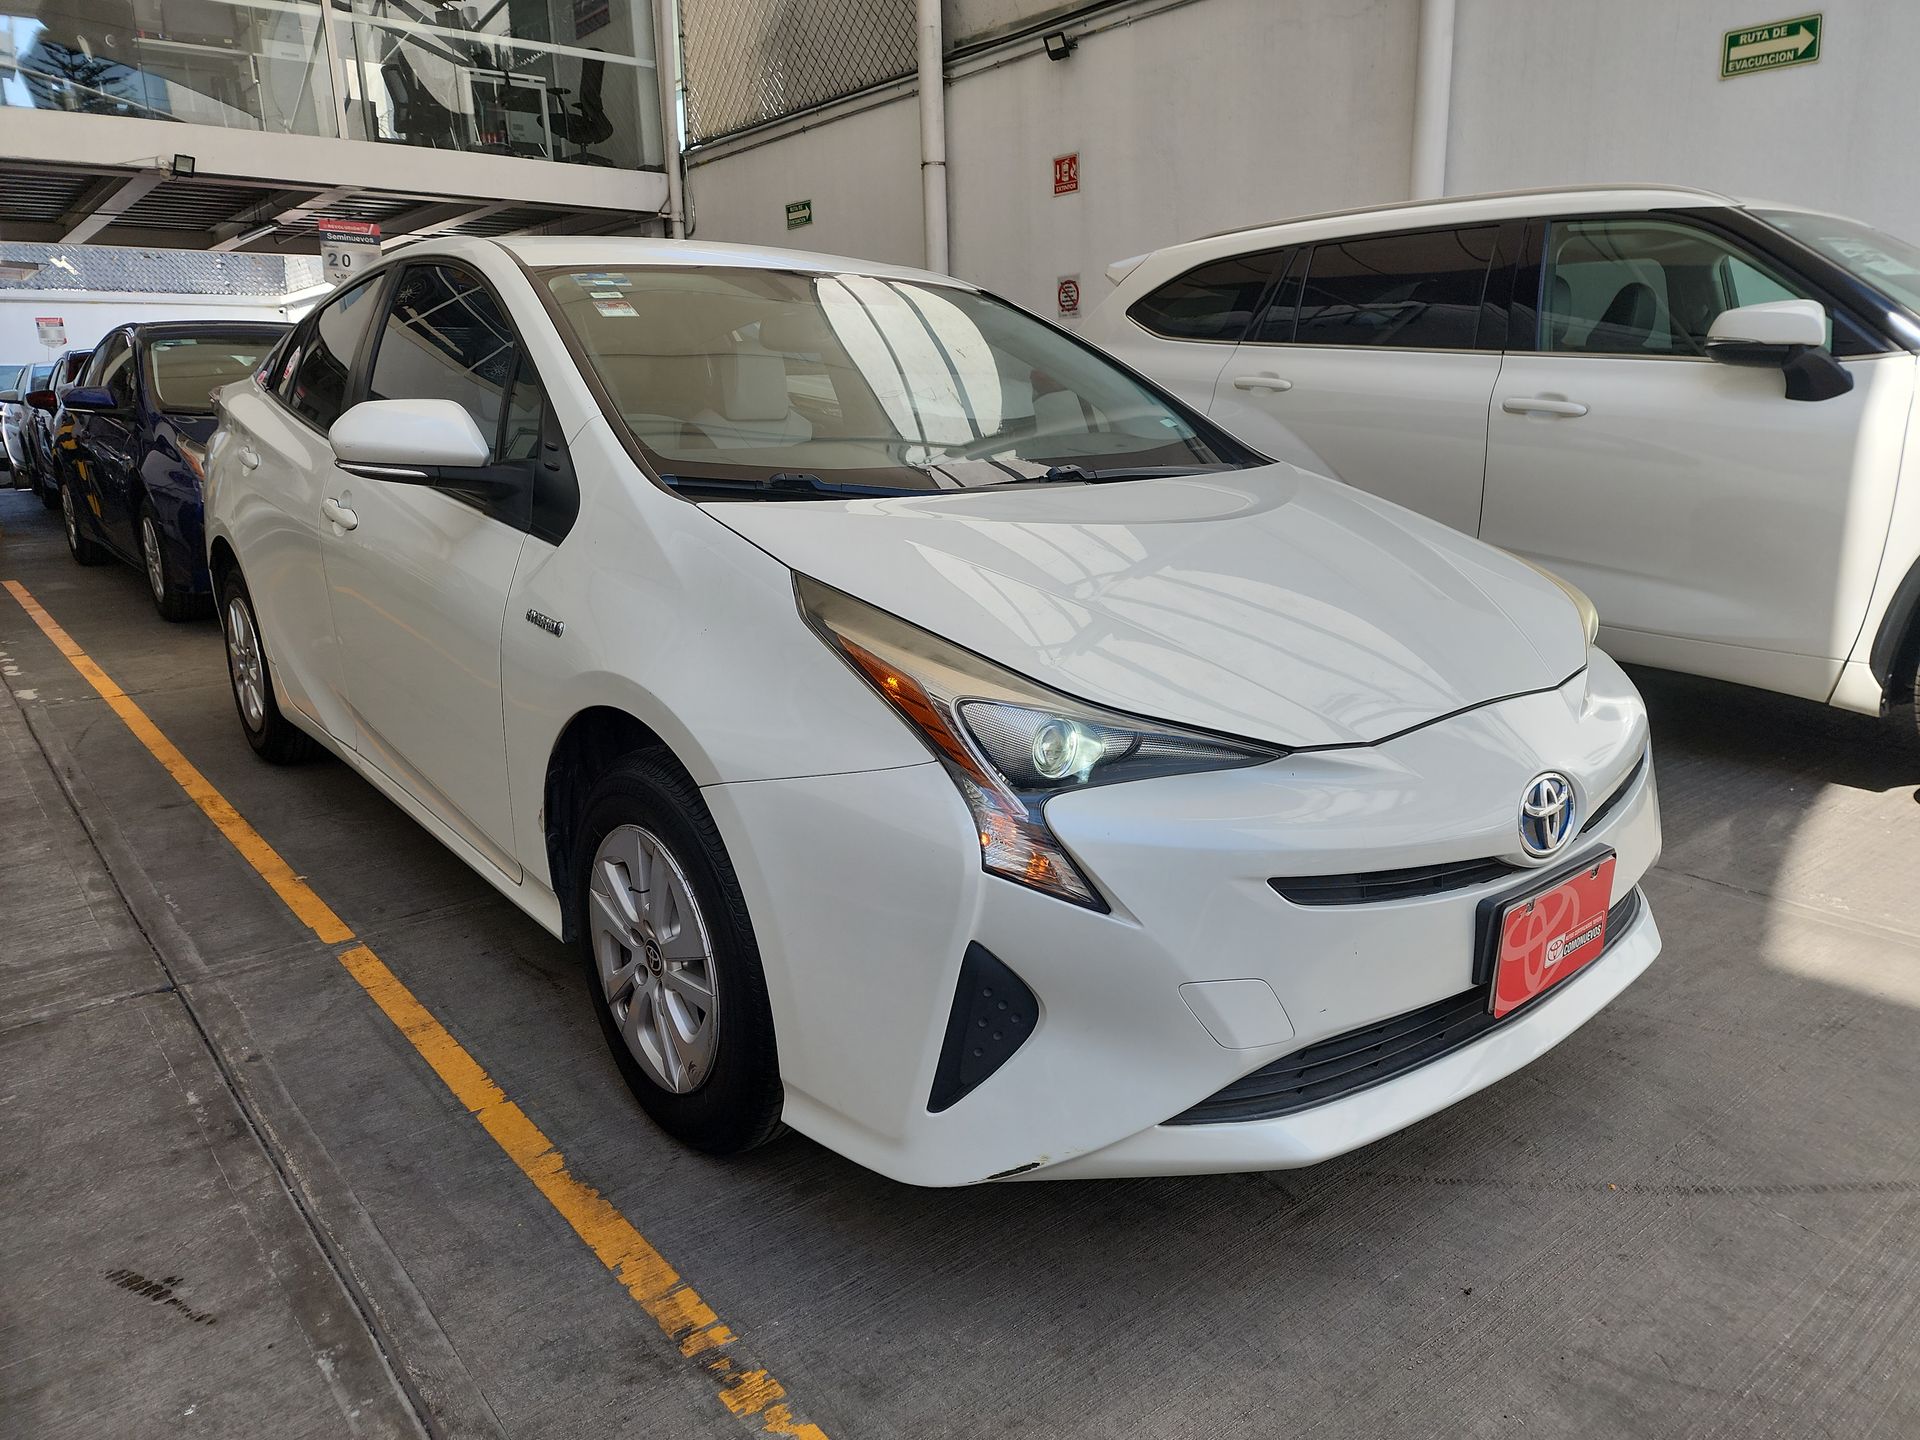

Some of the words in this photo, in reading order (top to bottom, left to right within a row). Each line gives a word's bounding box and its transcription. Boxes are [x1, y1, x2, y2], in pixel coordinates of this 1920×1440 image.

[1739, 30, 1769, 45] RUTA
[1772, 26, 1788, 38] DE
[1728, 50, 1794, 72] EVACUACION
[326, 232, 375, 244] Seminuevos
